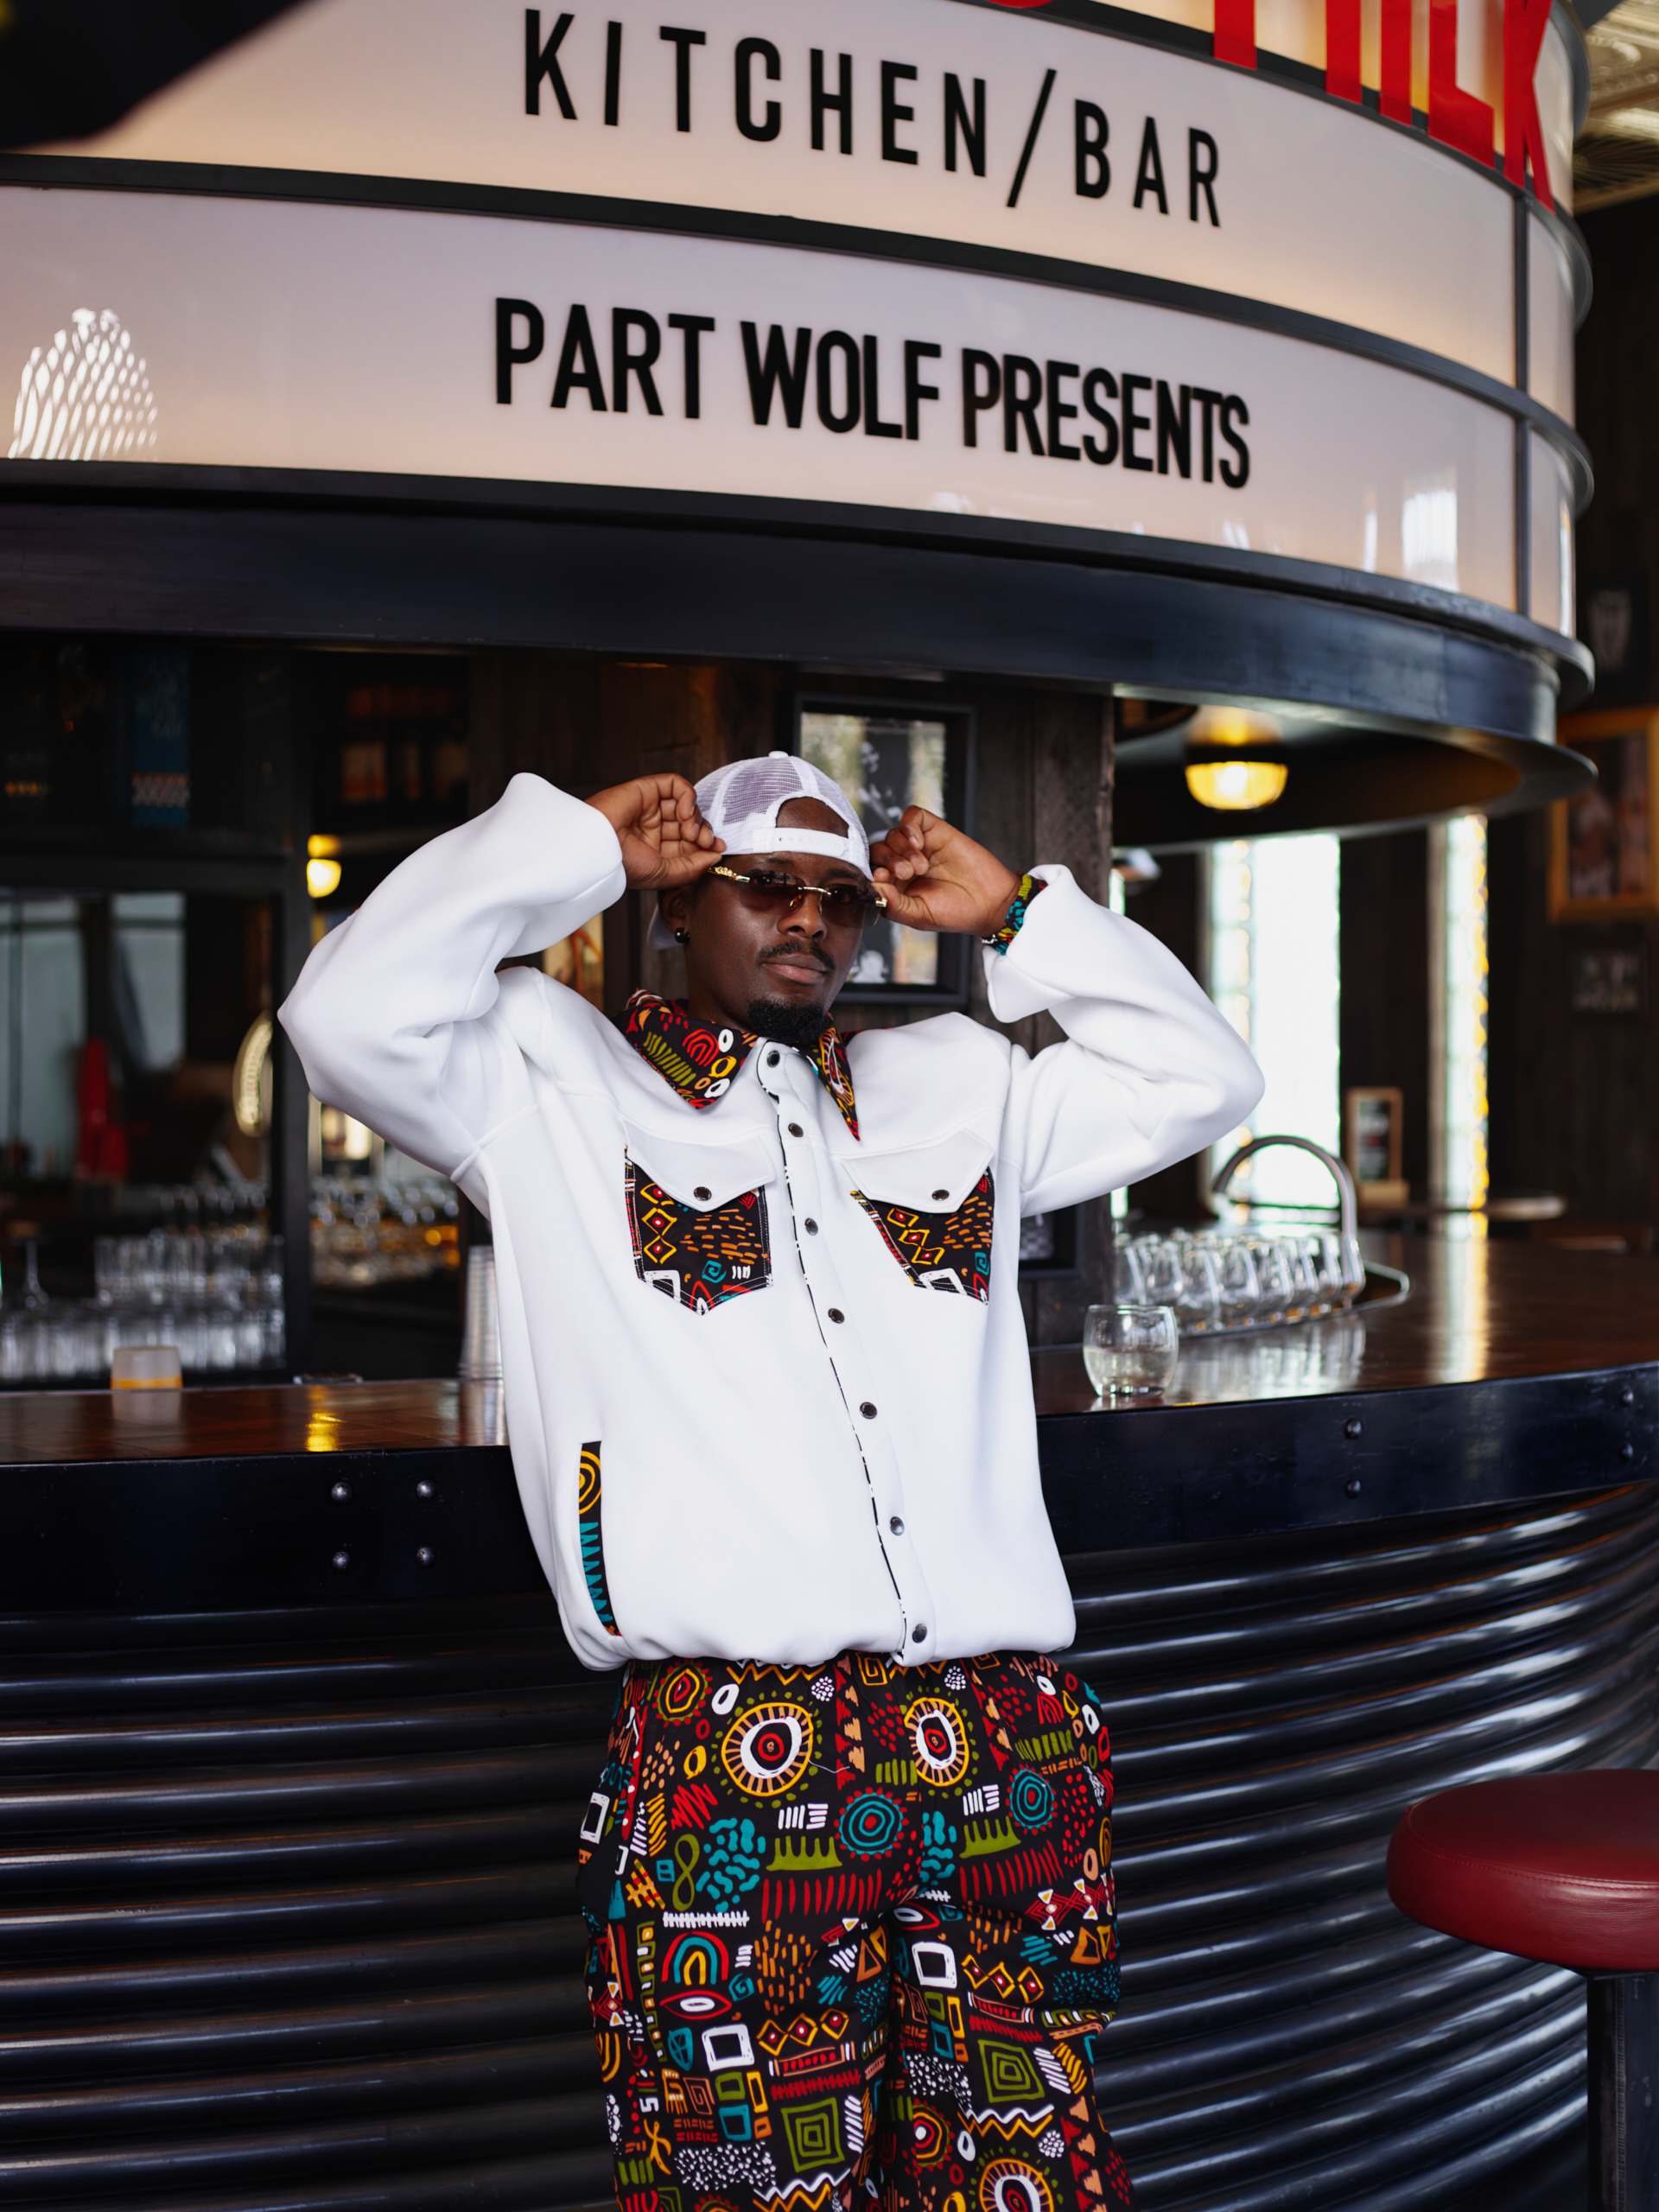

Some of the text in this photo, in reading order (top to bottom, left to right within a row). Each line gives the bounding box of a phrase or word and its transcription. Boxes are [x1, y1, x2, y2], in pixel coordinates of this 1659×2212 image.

[524, 7, 1221, 228] KITCHEN/BAR
[494, 296, 1251, 490] PART WOLF PRESENTS
